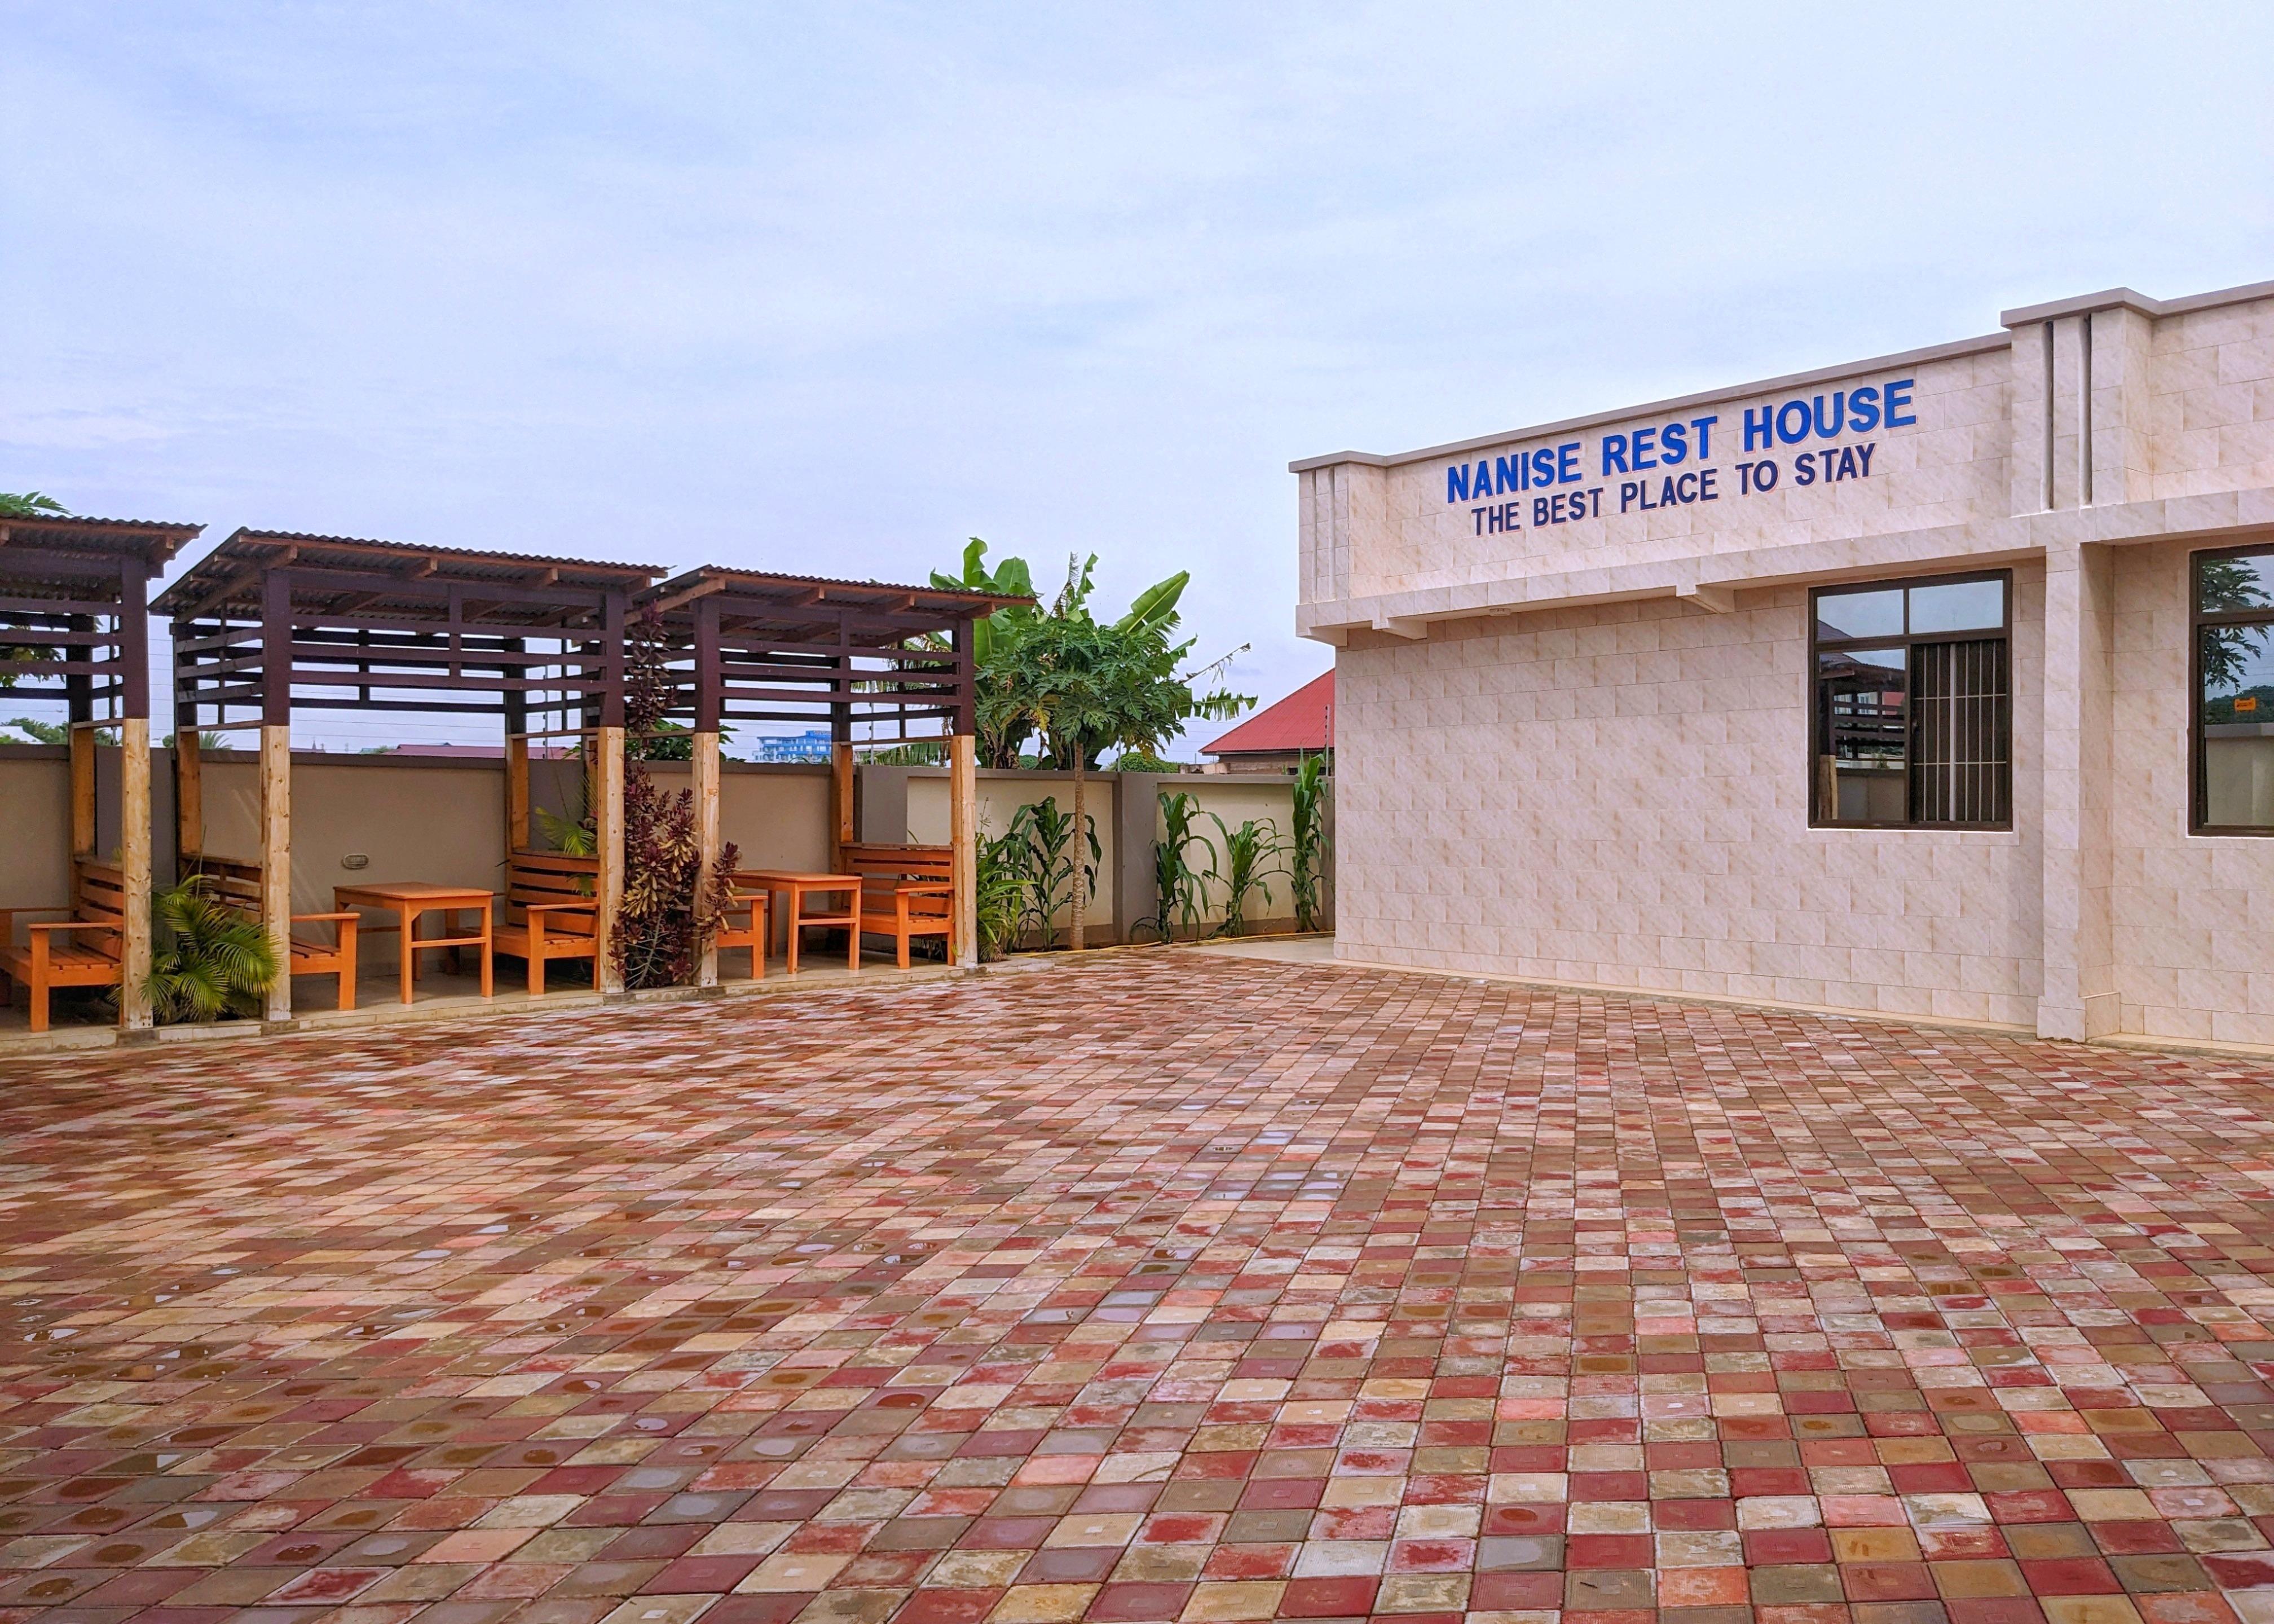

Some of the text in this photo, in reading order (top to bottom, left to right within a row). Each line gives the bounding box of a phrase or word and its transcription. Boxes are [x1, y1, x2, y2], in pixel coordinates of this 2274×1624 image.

[1447, 379, 1916, 504] NANISE REST HOUSE
[1471, 443, 1875, 535] THE BEST PLACE TO STAY
